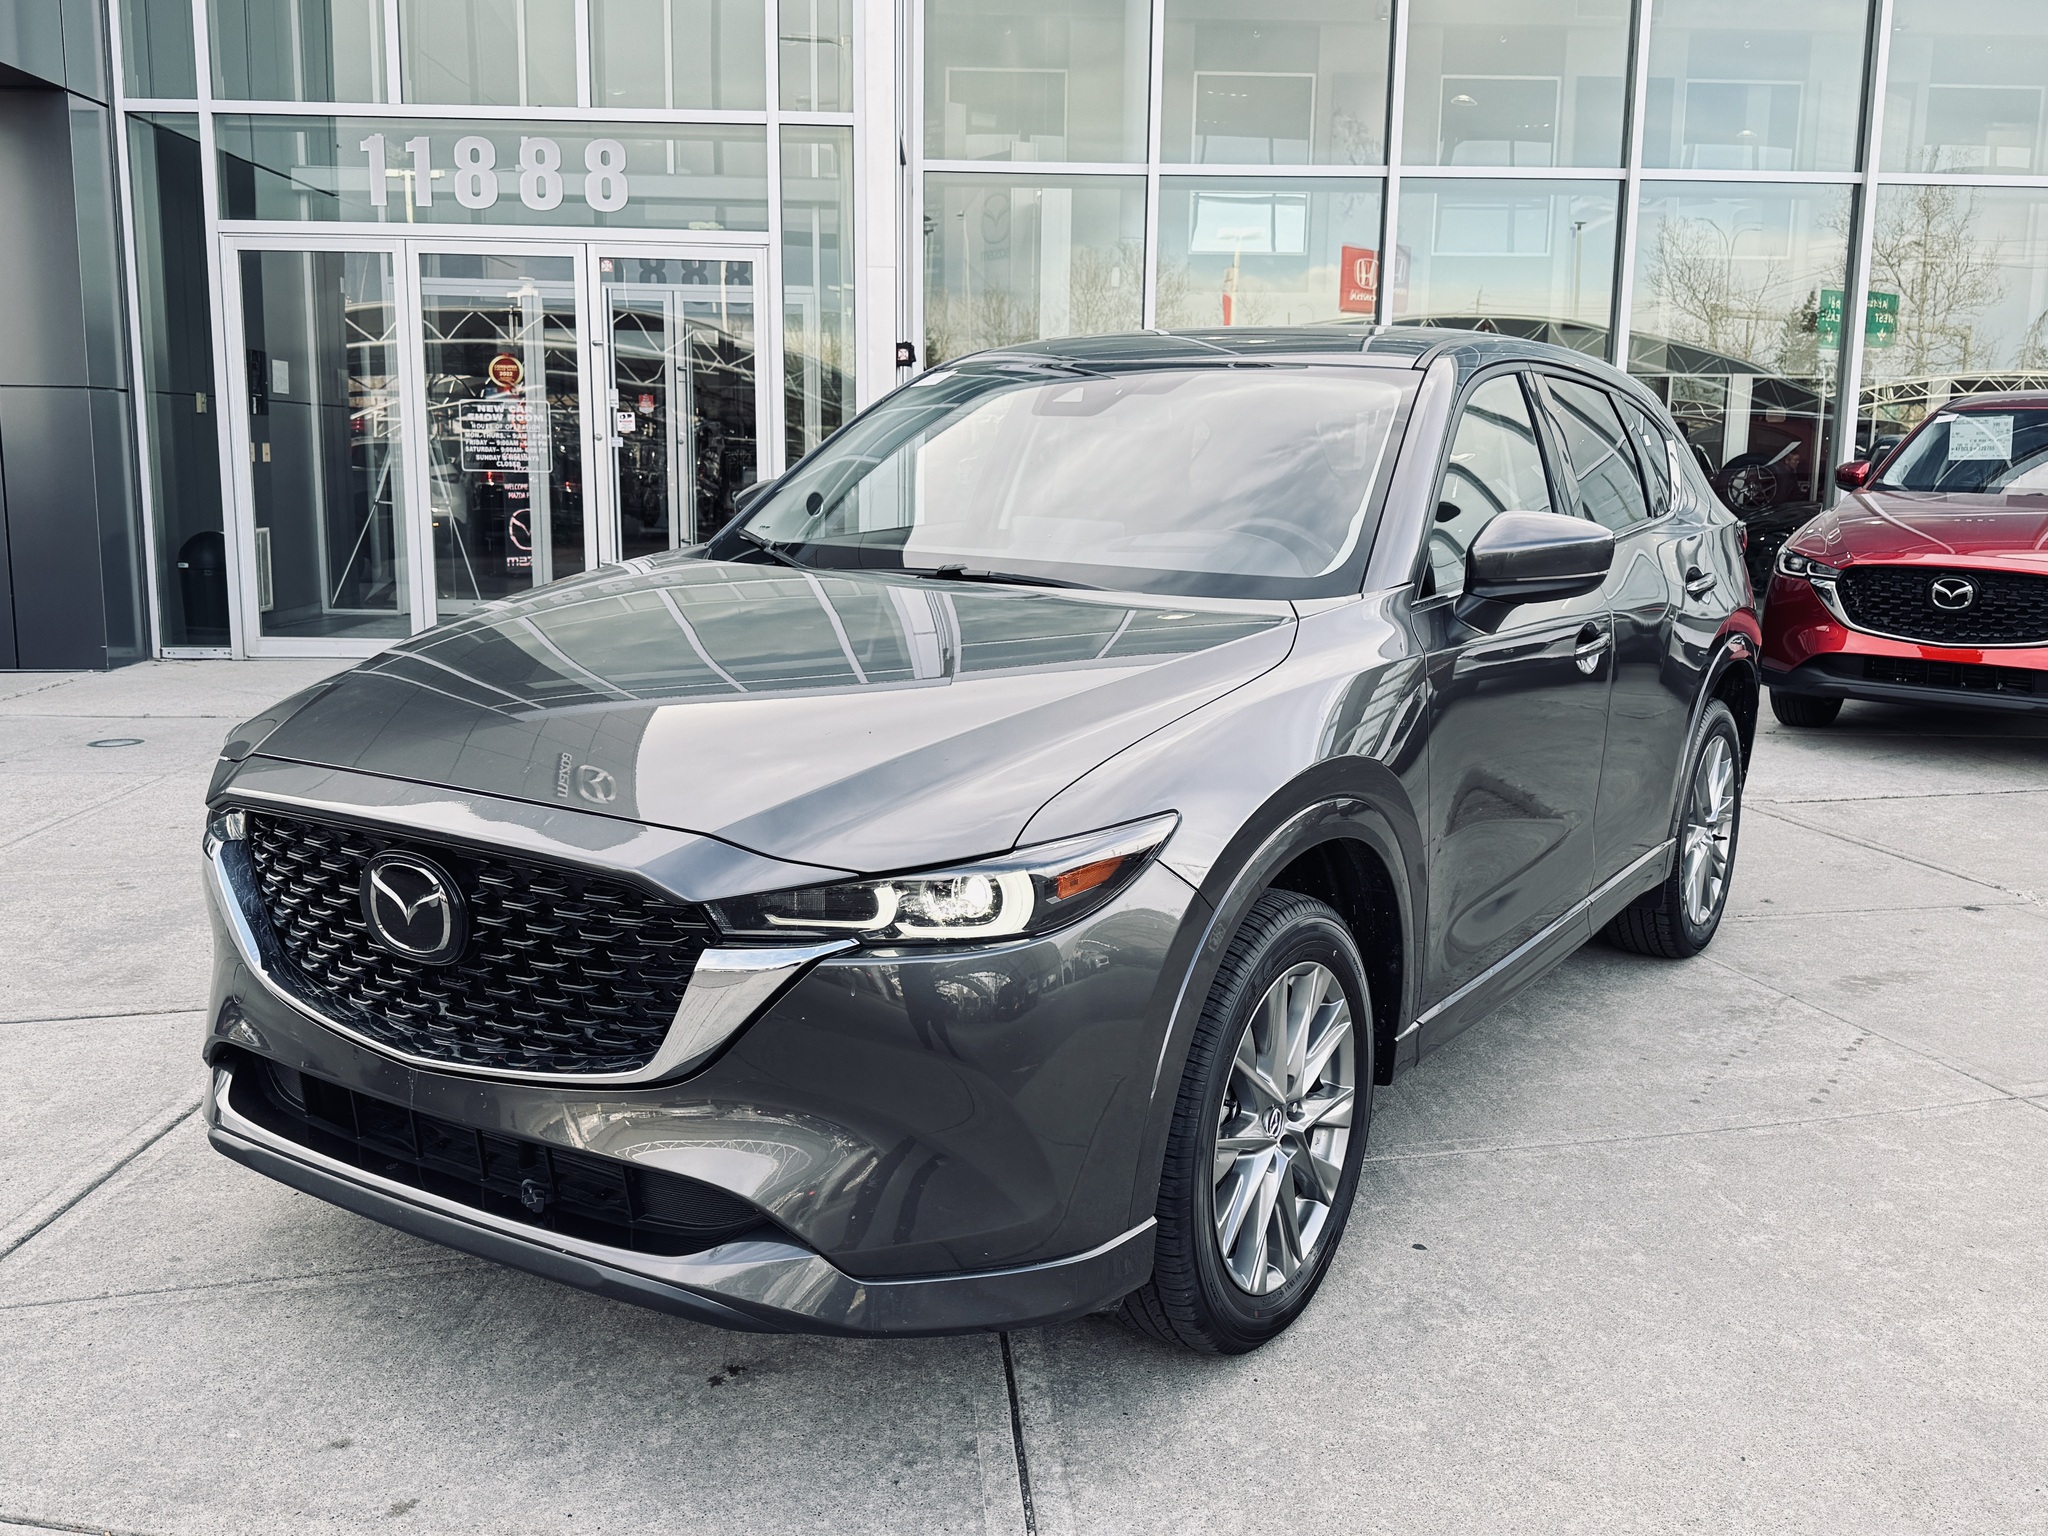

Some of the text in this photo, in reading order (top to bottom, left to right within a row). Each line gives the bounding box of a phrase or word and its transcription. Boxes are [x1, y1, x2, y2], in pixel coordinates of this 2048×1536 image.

[360, 134, 629, 212] 11888
[508, 405, 533, 413] CAR
[467, 413, 544, 422] SHOW ROOM
[503, 483, 528, 491] WELCOME
